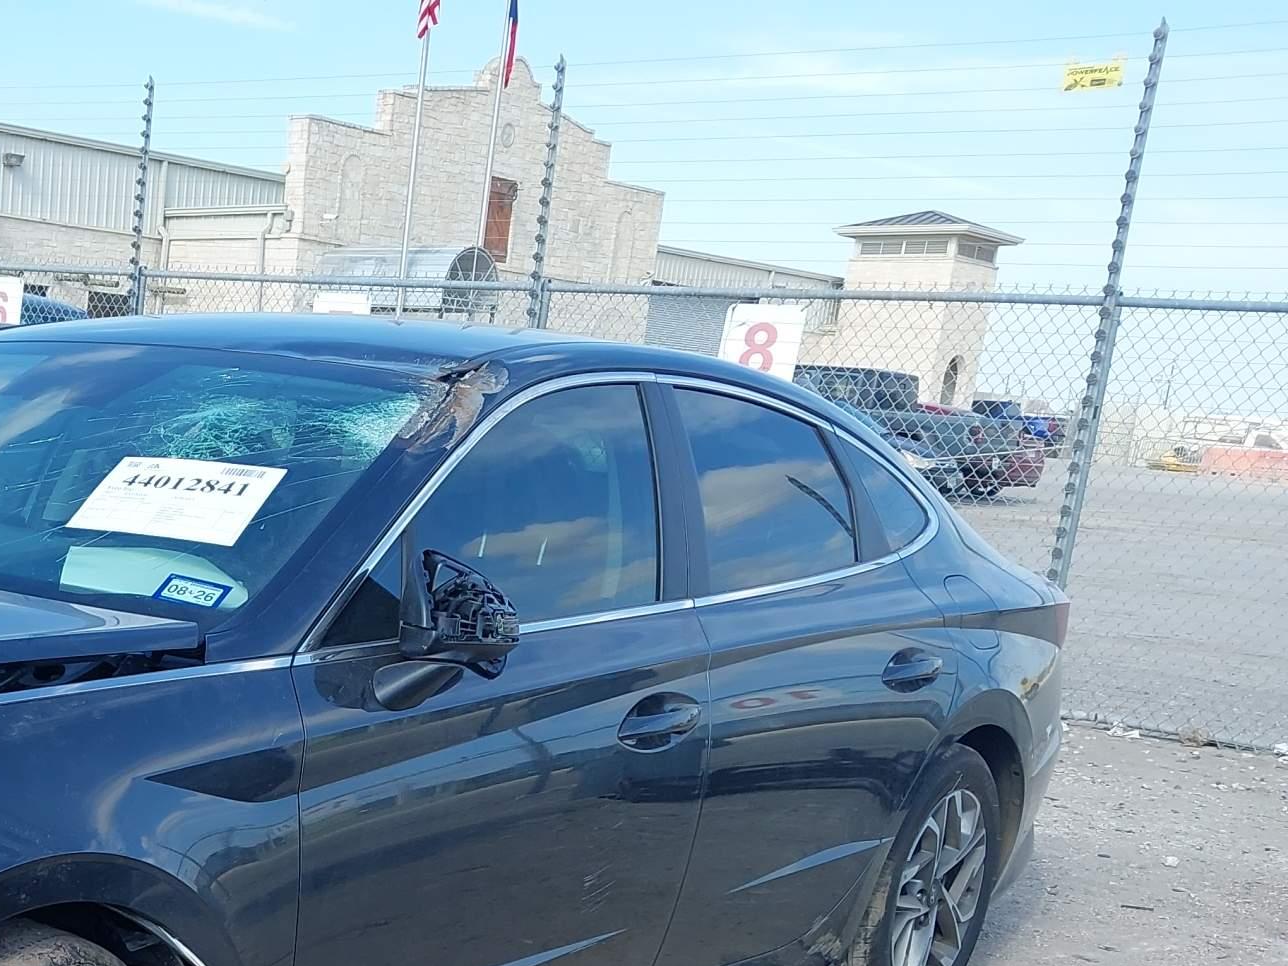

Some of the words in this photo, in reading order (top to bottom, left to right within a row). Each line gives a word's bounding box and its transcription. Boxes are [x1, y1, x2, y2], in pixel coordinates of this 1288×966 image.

[738, 322, 778, 372] 8
[122, 473, 250, 497] 44012841
[167, 584, 189, 596] 08
[193, 590, 217, 602] 26
